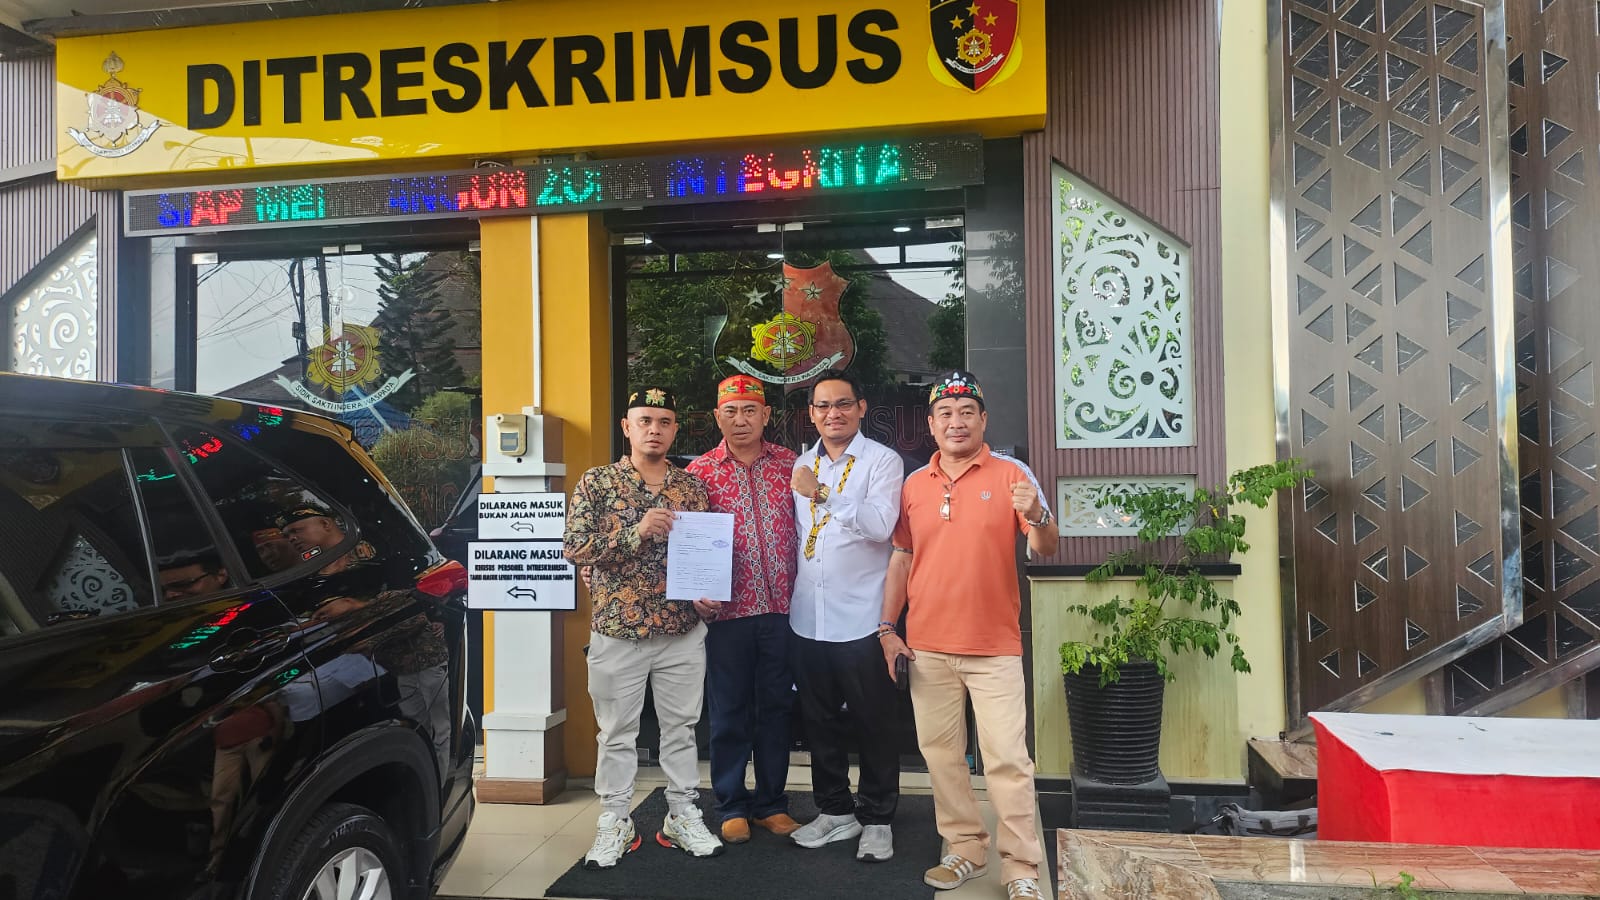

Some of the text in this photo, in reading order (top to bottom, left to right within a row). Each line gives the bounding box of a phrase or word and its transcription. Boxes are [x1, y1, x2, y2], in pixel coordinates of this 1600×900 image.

[187, 9, 902, 130] DITRESKRIMSUS
[295, 384, 311, 400] SIDIK
[311, 398, 333, 410] SAKTI
[333, 402, 363, 411] INDERA
[480, 500, 563, 510] DILARANG MASUK
[475, 550, 527, 560] DILARANG
